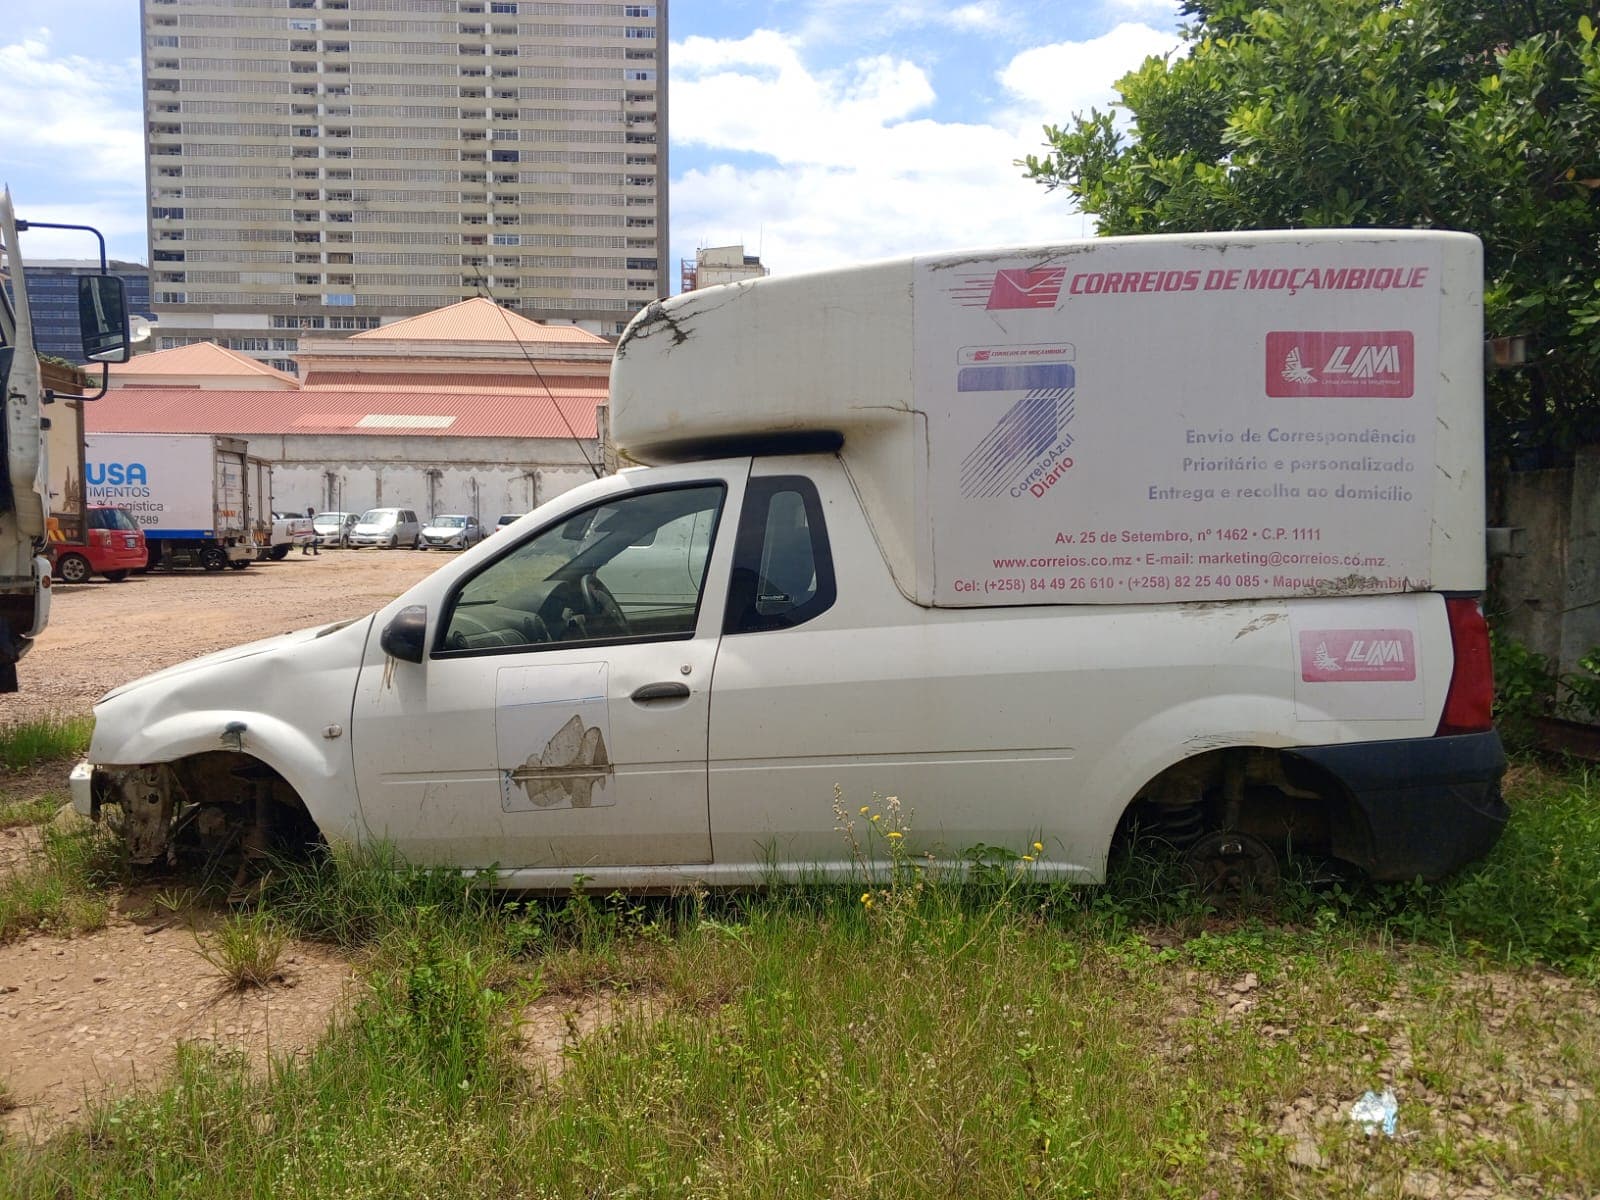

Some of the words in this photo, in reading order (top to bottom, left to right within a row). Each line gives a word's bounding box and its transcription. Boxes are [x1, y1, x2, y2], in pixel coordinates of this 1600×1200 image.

[1069, 270, 1201, 294] CORREIOS
[1204, 269, 1242, 291] DE
[1243, 267, 1430, 296] MOÇAMBIQUE
[1186, 429, 1234, 443] Envio
[1241, 428, 1261, 442] de
[1268, 427, 1416, 445] Correspondência
[1183, 457, 1267, 472] Prioritário
[1274, 460, 1284, 470] e
[1291, 456, 1415, 473] personalizado
[1029, 457, 1073, 498] Diário
[1149, 485, 1214, 502] Entrega
[1221, 487, 1231, 498] e
[1237, 482, 1300, 498] recolha
[1307, 487, 1328, 498] ao
[1335, 483, 1413, 501] domicílio
[1055, 531, 1076, 545] Av.
[1080, 531, 1096, 544] 25
[1100, 531, 1117, 543] de
[1121, 530, 1193, 543] Setembro,
[1216, 528, 1248, 541] 1462
[1262, 527, 1288, 540] C.P.
[1292, 527, 1321, 541] 1111
[993, 554, 1132, 569] www.correios.co.mz
[1145, 552, 1194, 566] E-mail:
[1199, 551, 1385, 567] marketing@correios.co.mz
[954, 579, 980, 592] Cel:
[984, 578, 1026, 594] (+258)
[1030, 578, 1046, 591] 84
[1050, 578, 1066, 590] 49
[1070, 577, 1086, 590] 26
[1090, 577, 1114, 590] 610
[1127, 575, 1170, 592] (+258)
[1174, 575, 1191, 588] 82
[1195, 575, 1211, 588] 25
[1215, 575, 1231, 587] 40
[1235, 575, 1260, 588] 085
